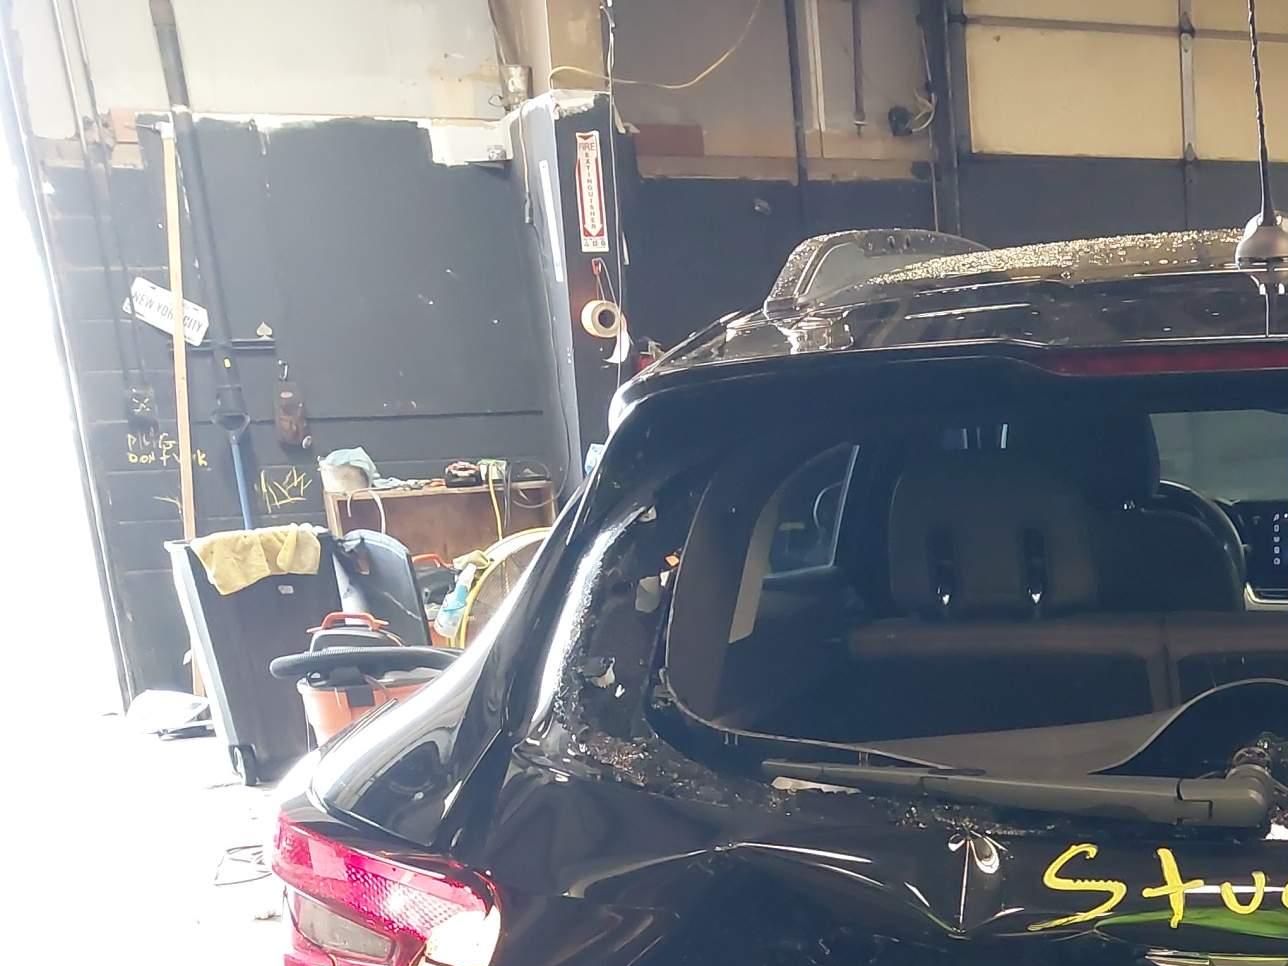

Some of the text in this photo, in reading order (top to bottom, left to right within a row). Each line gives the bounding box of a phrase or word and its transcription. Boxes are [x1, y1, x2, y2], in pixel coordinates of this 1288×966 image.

[579, 142, 597, 151] FIRE
[584, 151, 597, 230] EXTINGUISHER
[132, 291, 153, 310] NEW
[183, 315, 204, 333] CITY
